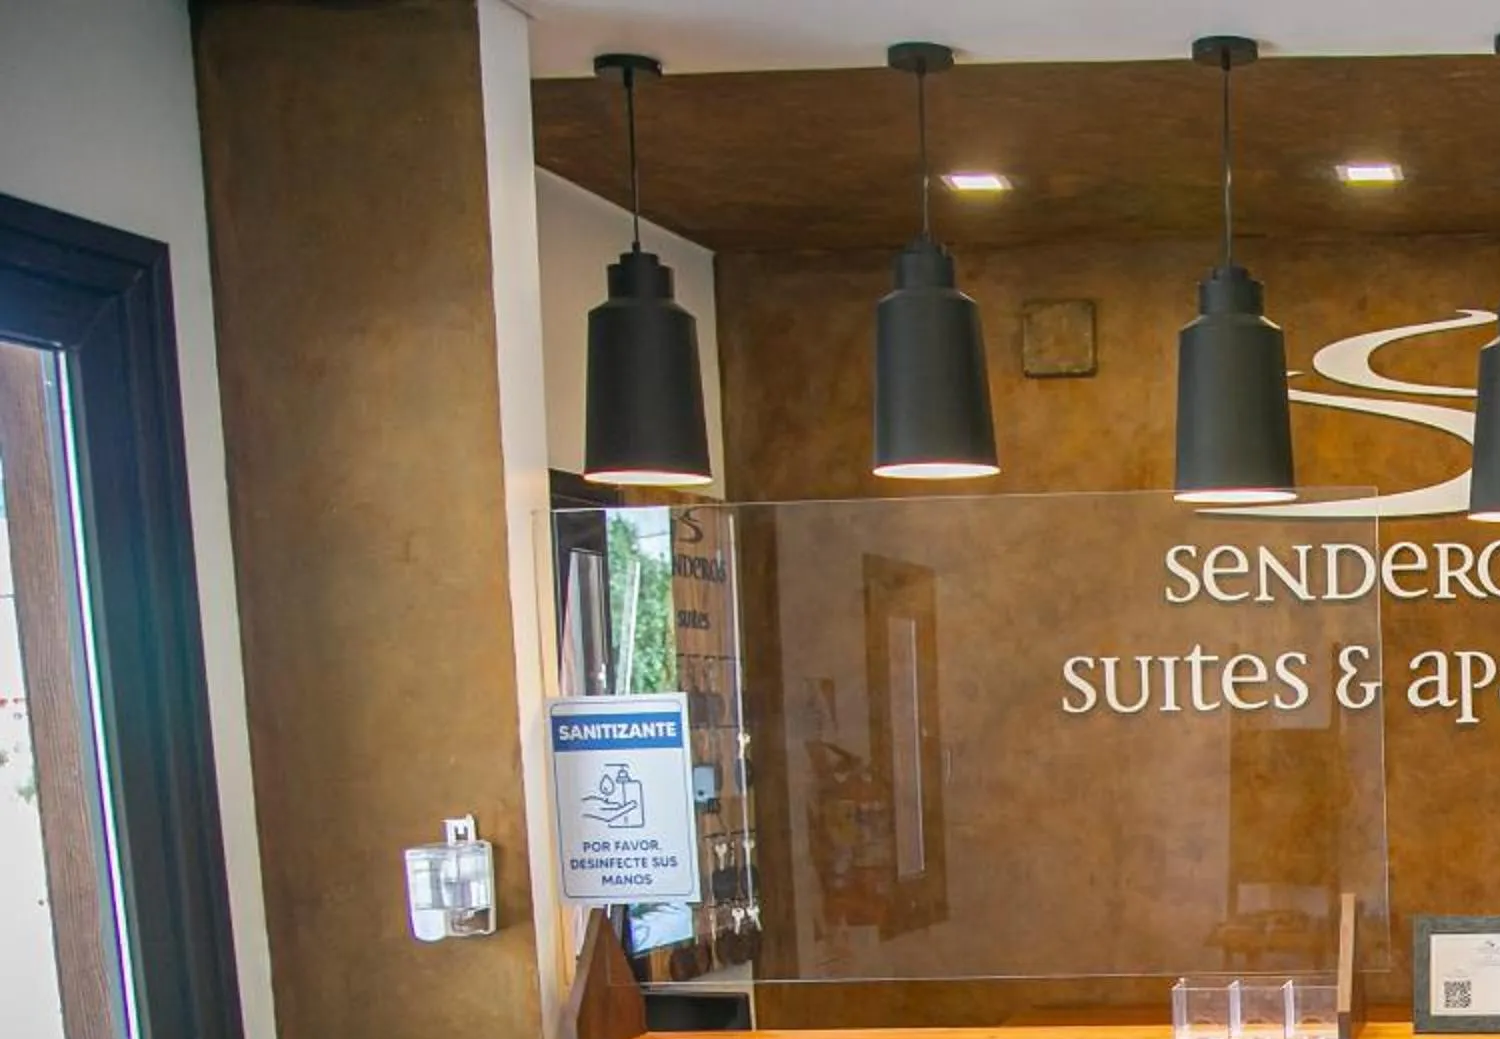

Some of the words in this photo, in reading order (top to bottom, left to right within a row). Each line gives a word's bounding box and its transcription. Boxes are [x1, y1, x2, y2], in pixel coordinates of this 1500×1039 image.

[1336, 645, 1382, 709] &
[559, 720, 677, 741] SANITIZANTE
[583, 841, 611, 852] POR
[570, 857, 649, 870] DESINFECTE
[651, 856, 678, 868] SUS
[601, 874, 654, 886] MANOS
